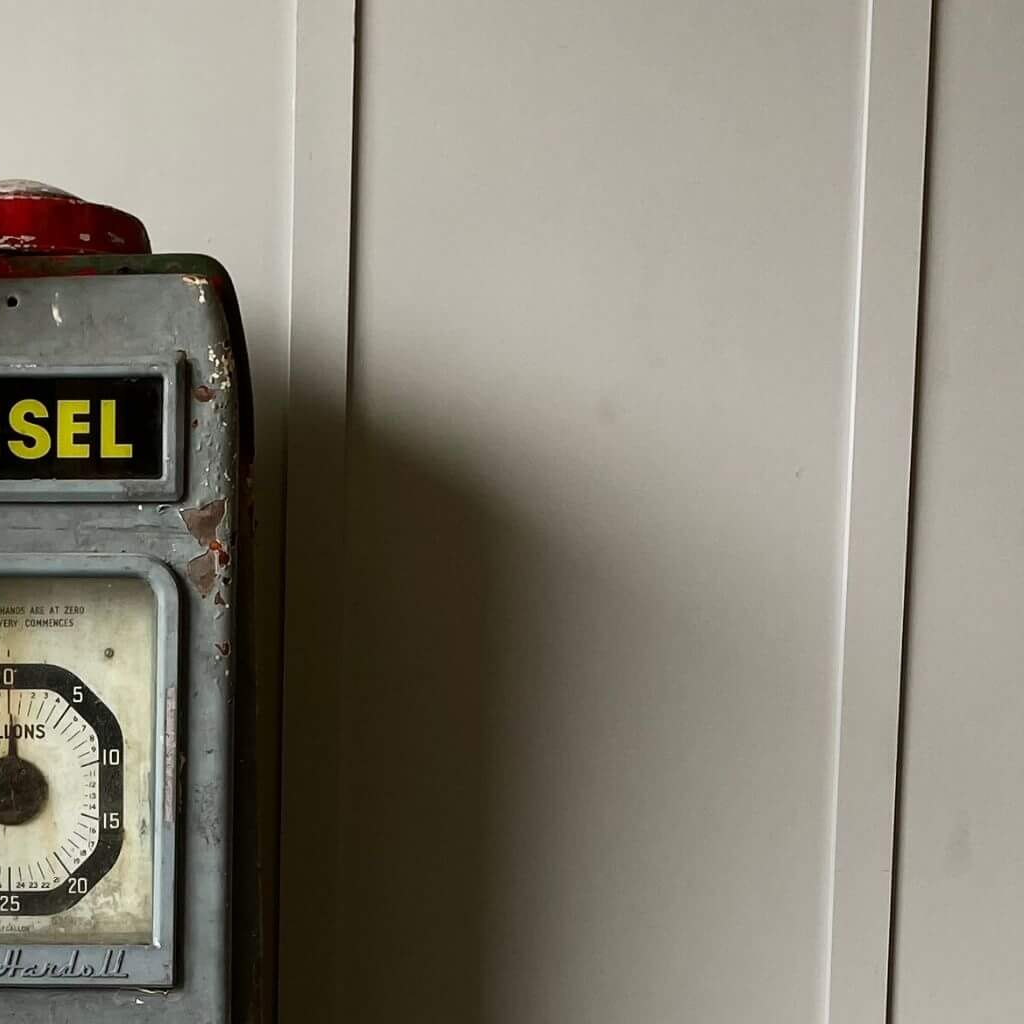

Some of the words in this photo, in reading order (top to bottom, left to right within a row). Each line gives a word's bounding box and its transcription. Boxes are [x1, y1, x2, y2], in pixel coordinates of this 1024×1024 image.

[0, 607, 24, 616] HANDS
[30, 607, 44, 615] ARE
[49, 606, 59, 615] AT
[64, 606, 85, 615] ZERO
[25, 618, 74, 628] COMMENCES
[3, 668, 14, 685] 0
[72, 686, 83, 703] 5
[103, 749, 120, 766] 10
[103, 812, 120, 829] 15
[68, 877, 88, 894] 20
[0, 895, 20, 912] 25
